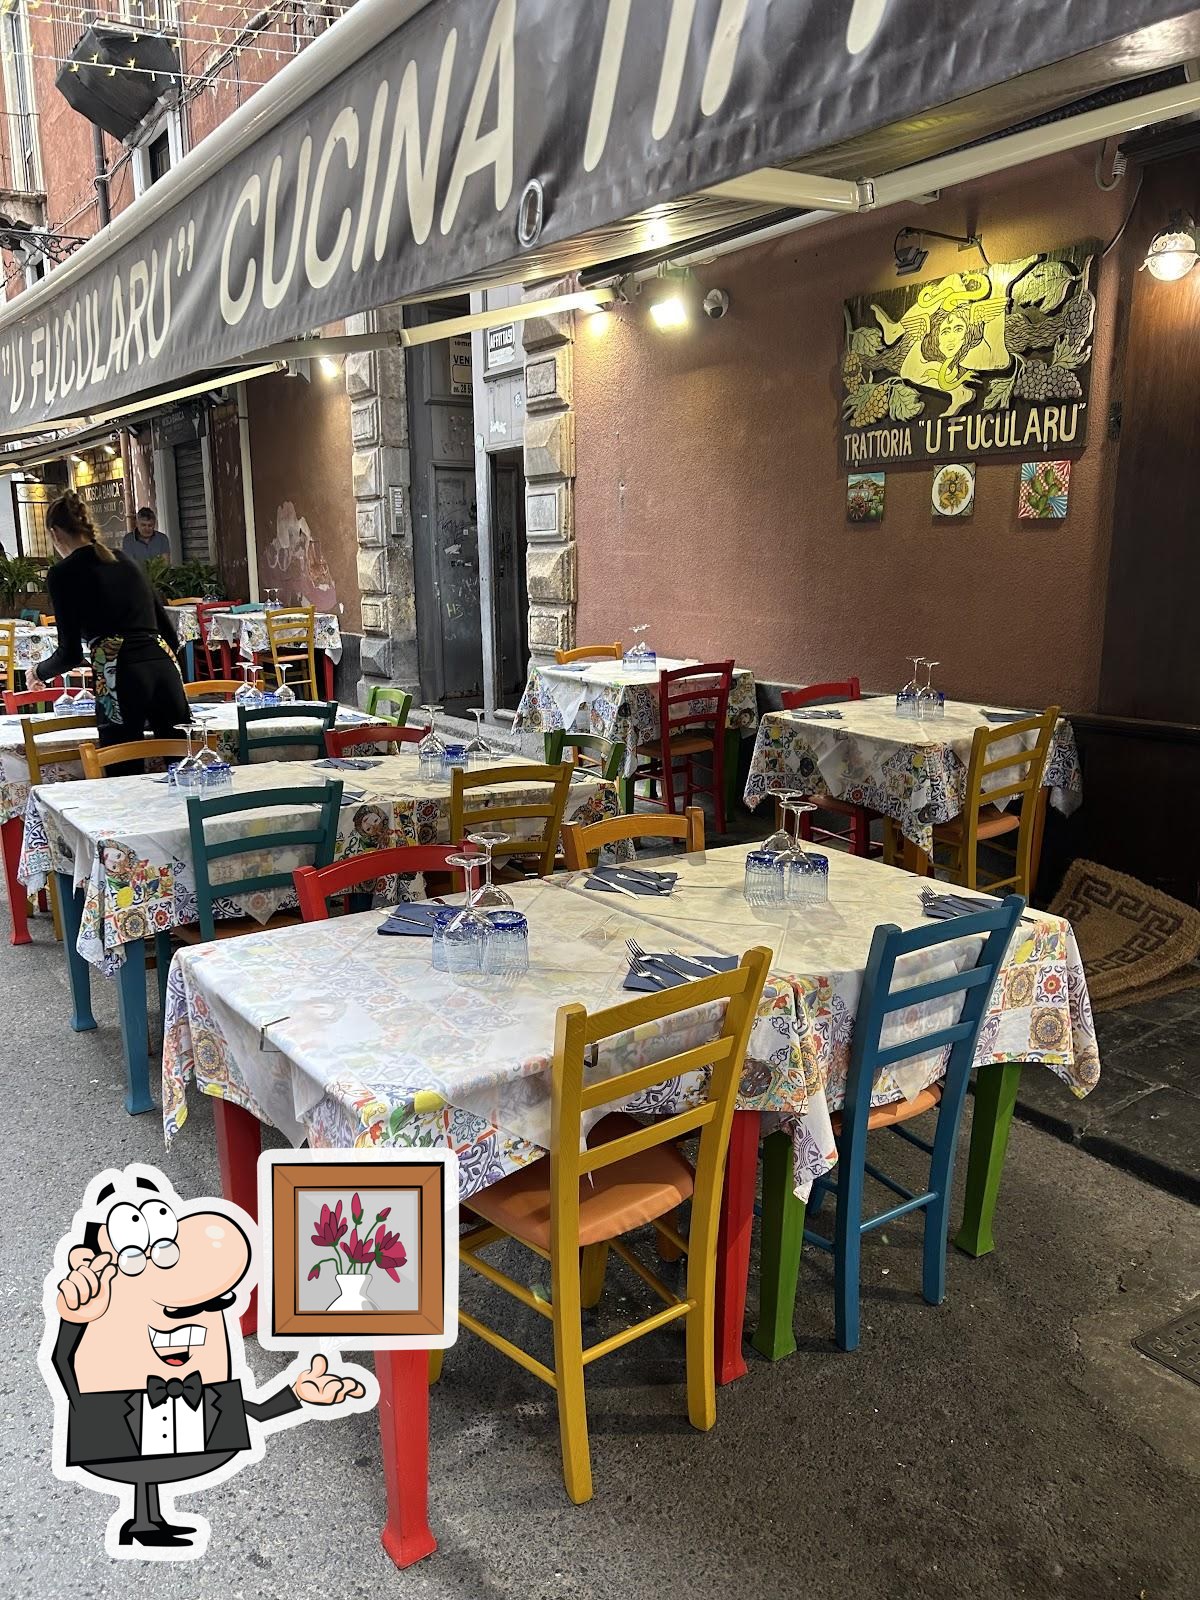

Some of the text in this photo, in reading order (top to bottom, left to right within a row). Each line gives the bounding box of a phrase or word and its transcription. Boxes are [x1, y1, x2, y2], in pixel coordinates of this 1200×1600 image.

[30, 219, 195, 409] FUCULARU"
[220, 0, 516, 325] CUCINA
[844, 427, 912, 461] TRATTORIA
[947, 402, 1086, 451] FUCULARU"
